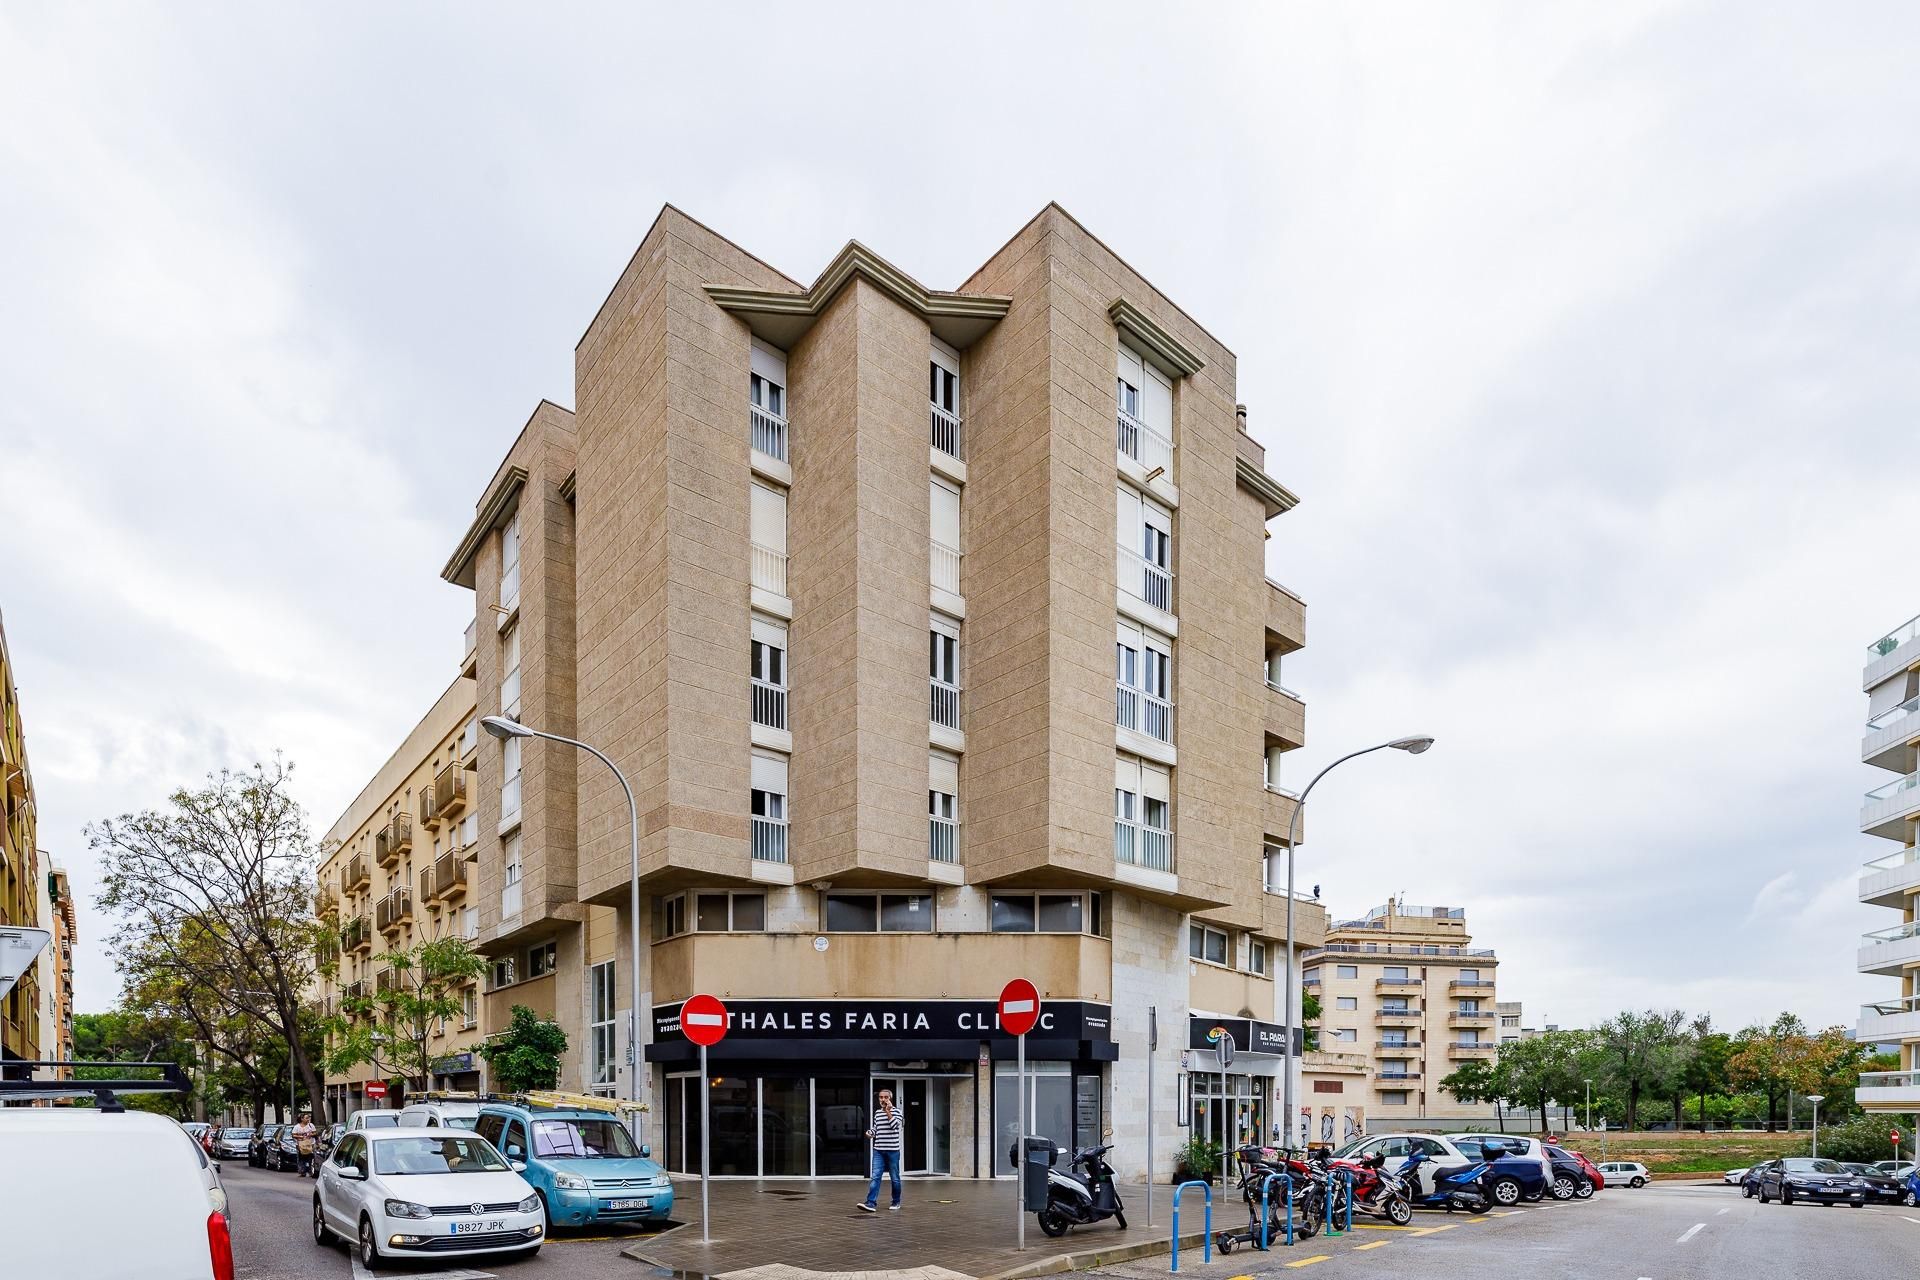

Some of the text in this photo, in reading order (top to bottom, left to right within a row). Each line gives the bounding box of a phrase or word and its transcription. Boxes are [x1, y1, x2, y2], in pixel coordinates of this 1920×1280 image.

[727, 1012, 1054, 1030] THALES FARIA CLIC
[1260, 1031, 1294, 1043] EL PARA
[457, 1221, 505, 1233] 9827 JPK
